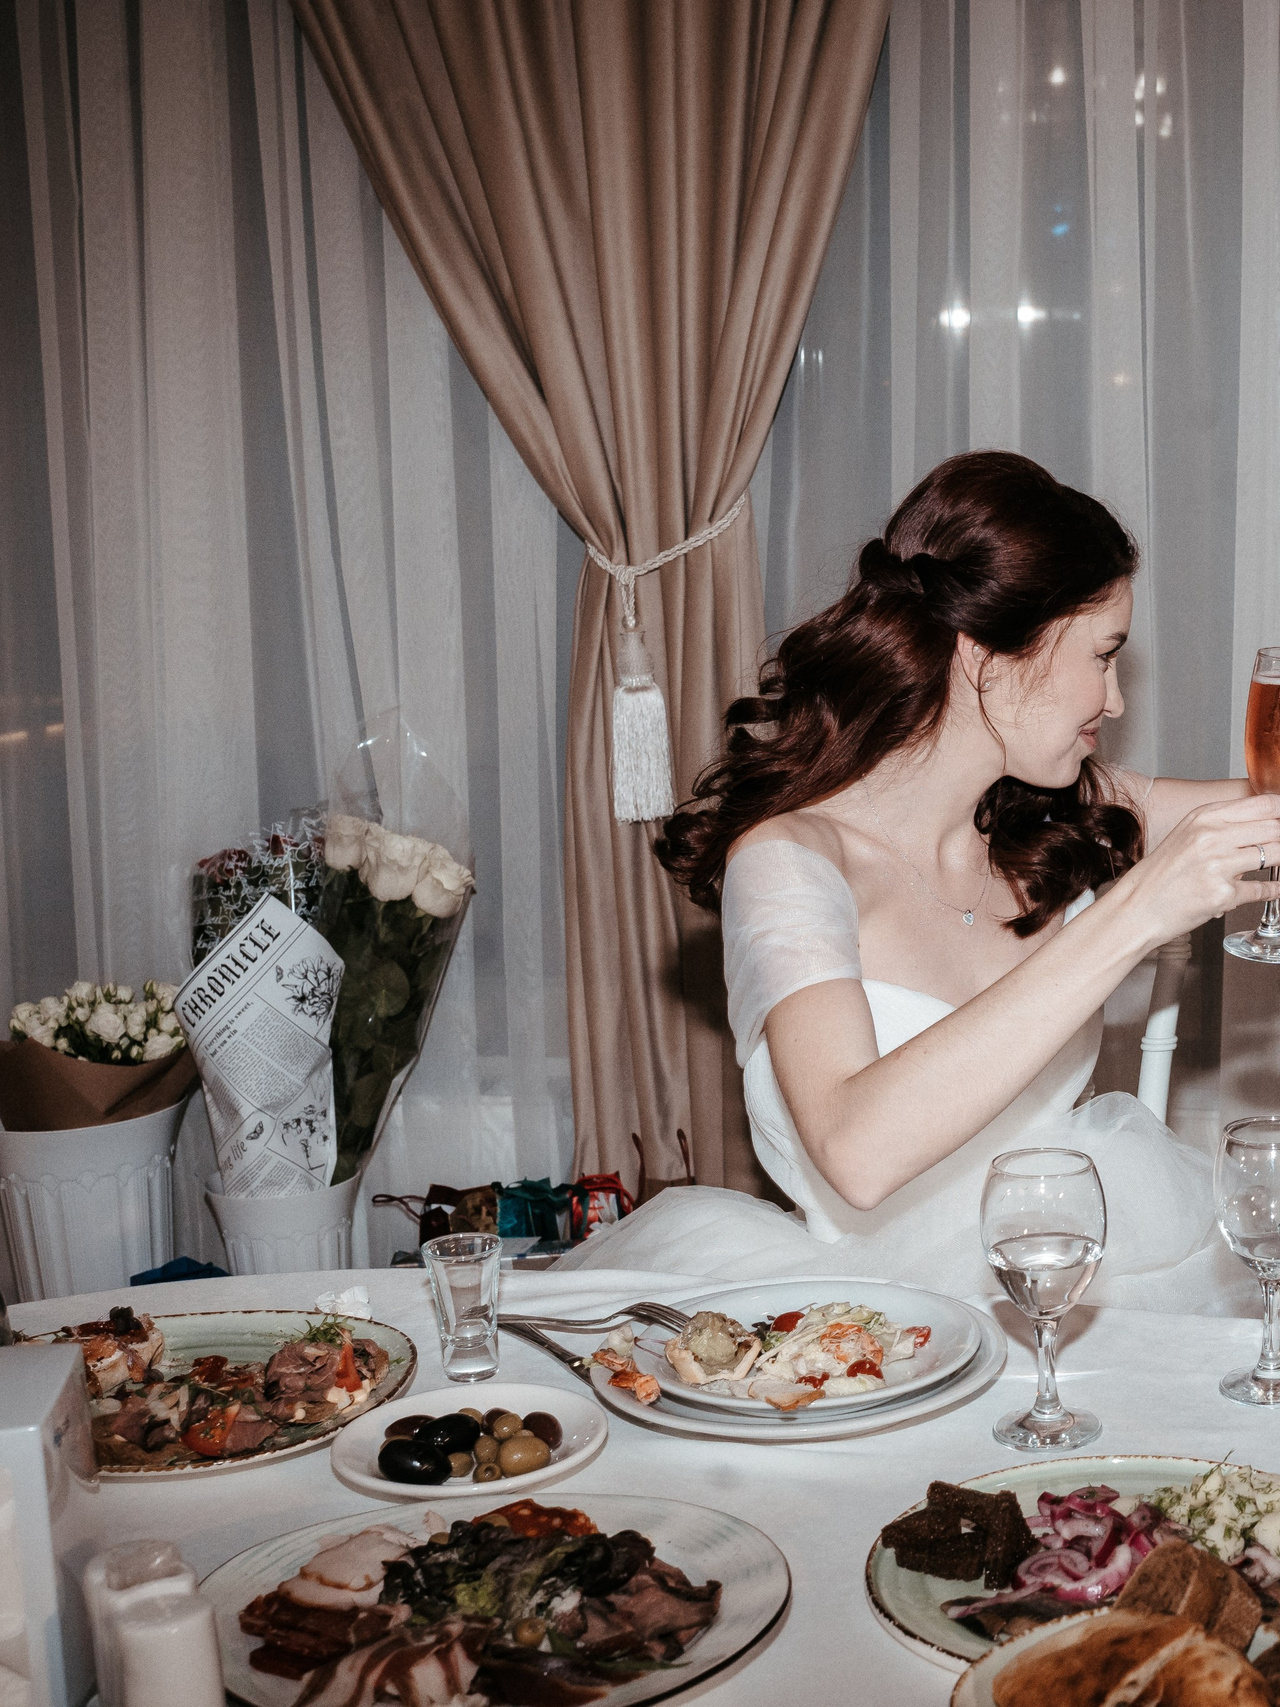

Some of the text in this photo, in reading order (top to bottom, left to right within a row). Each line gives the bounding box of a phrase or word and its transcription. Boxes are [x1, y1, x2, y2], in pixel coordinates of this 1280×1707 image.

[182, 918, 281, 1028] CHRONICLE
[204, 1024, 231, 1051] Everything
[217, 1039, 228, 1051] you
[227, 1029, 238, 1039] win
[230, 1139, 248, 1161] life
